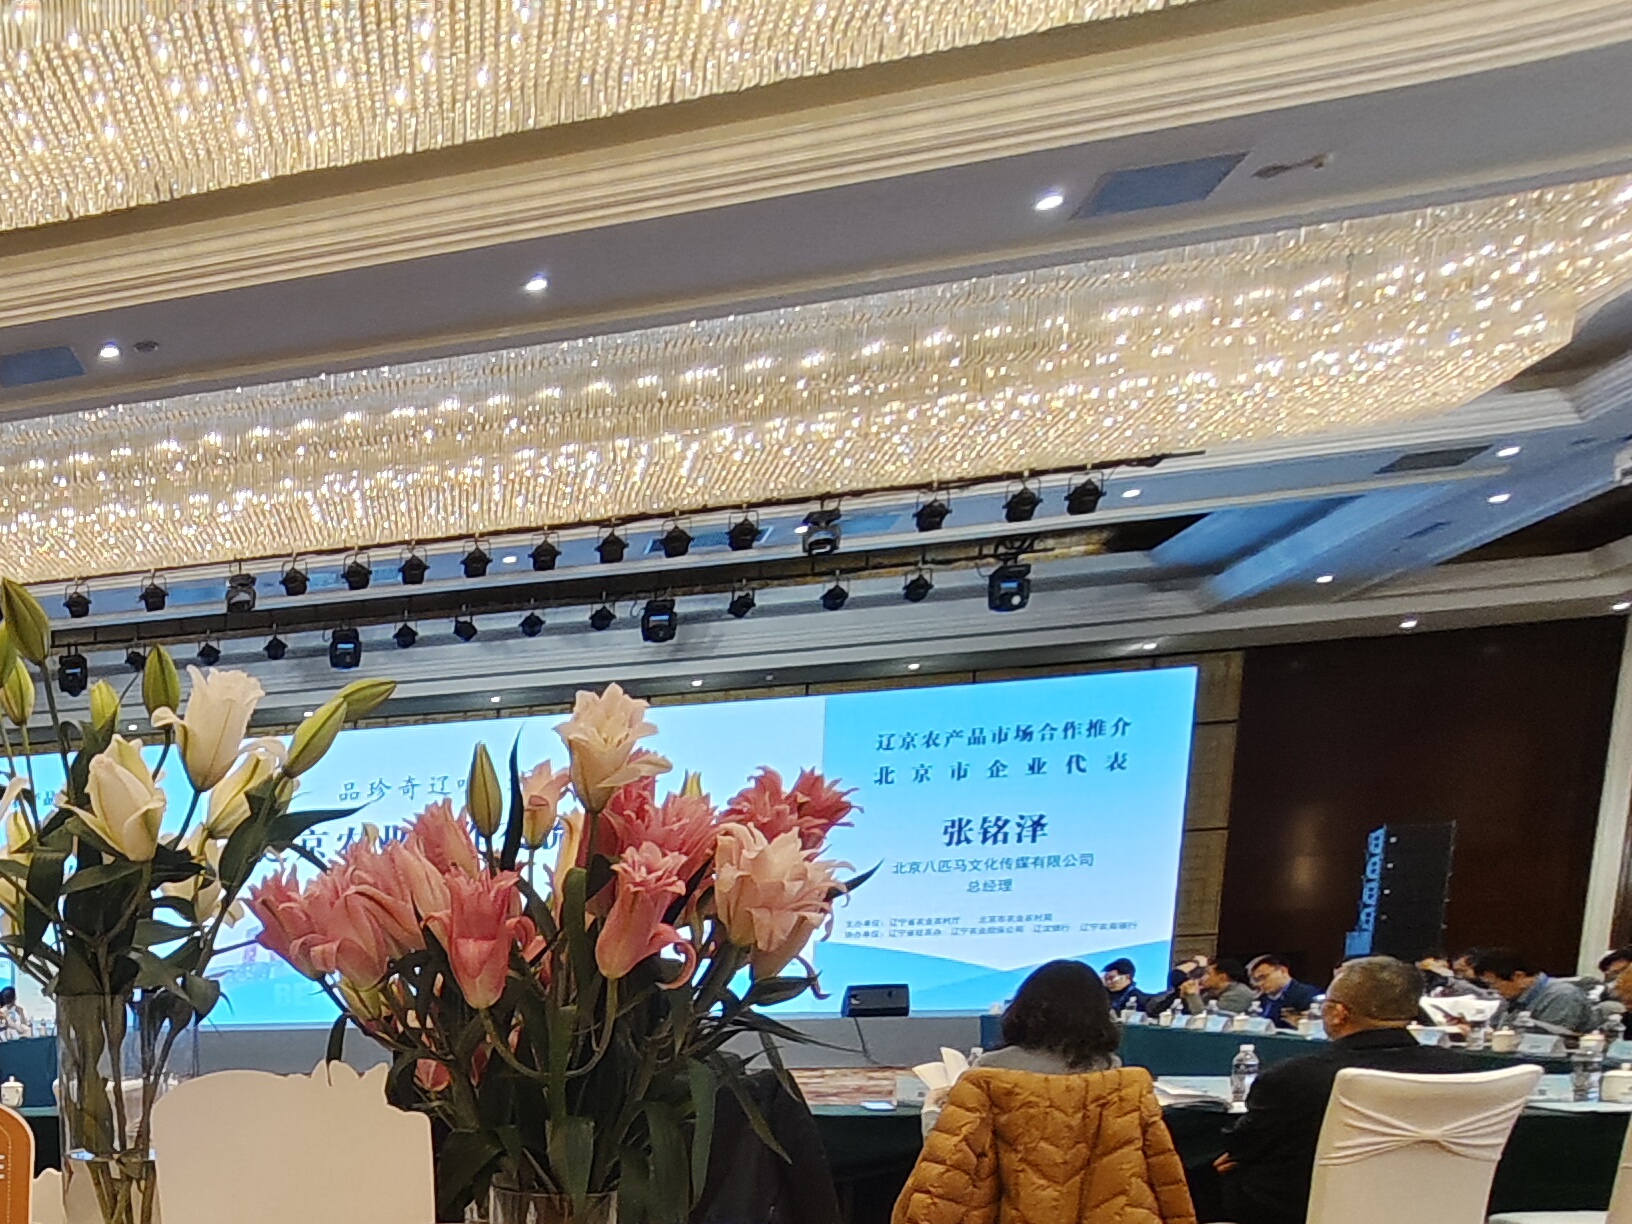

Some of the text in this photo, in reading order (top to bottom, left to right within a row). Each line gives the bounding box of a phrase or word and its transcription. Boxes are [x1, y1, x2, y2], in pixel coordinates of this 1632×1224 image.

[875, 716, 1132, 752] 辽京农产品市场合作推介
[941, 813, 1050, 847] 张铭泽
[892, 853, 1095, 875] 北京八匹马文化传媒有限公司
[966, 877, 1013, 894] 总经理
